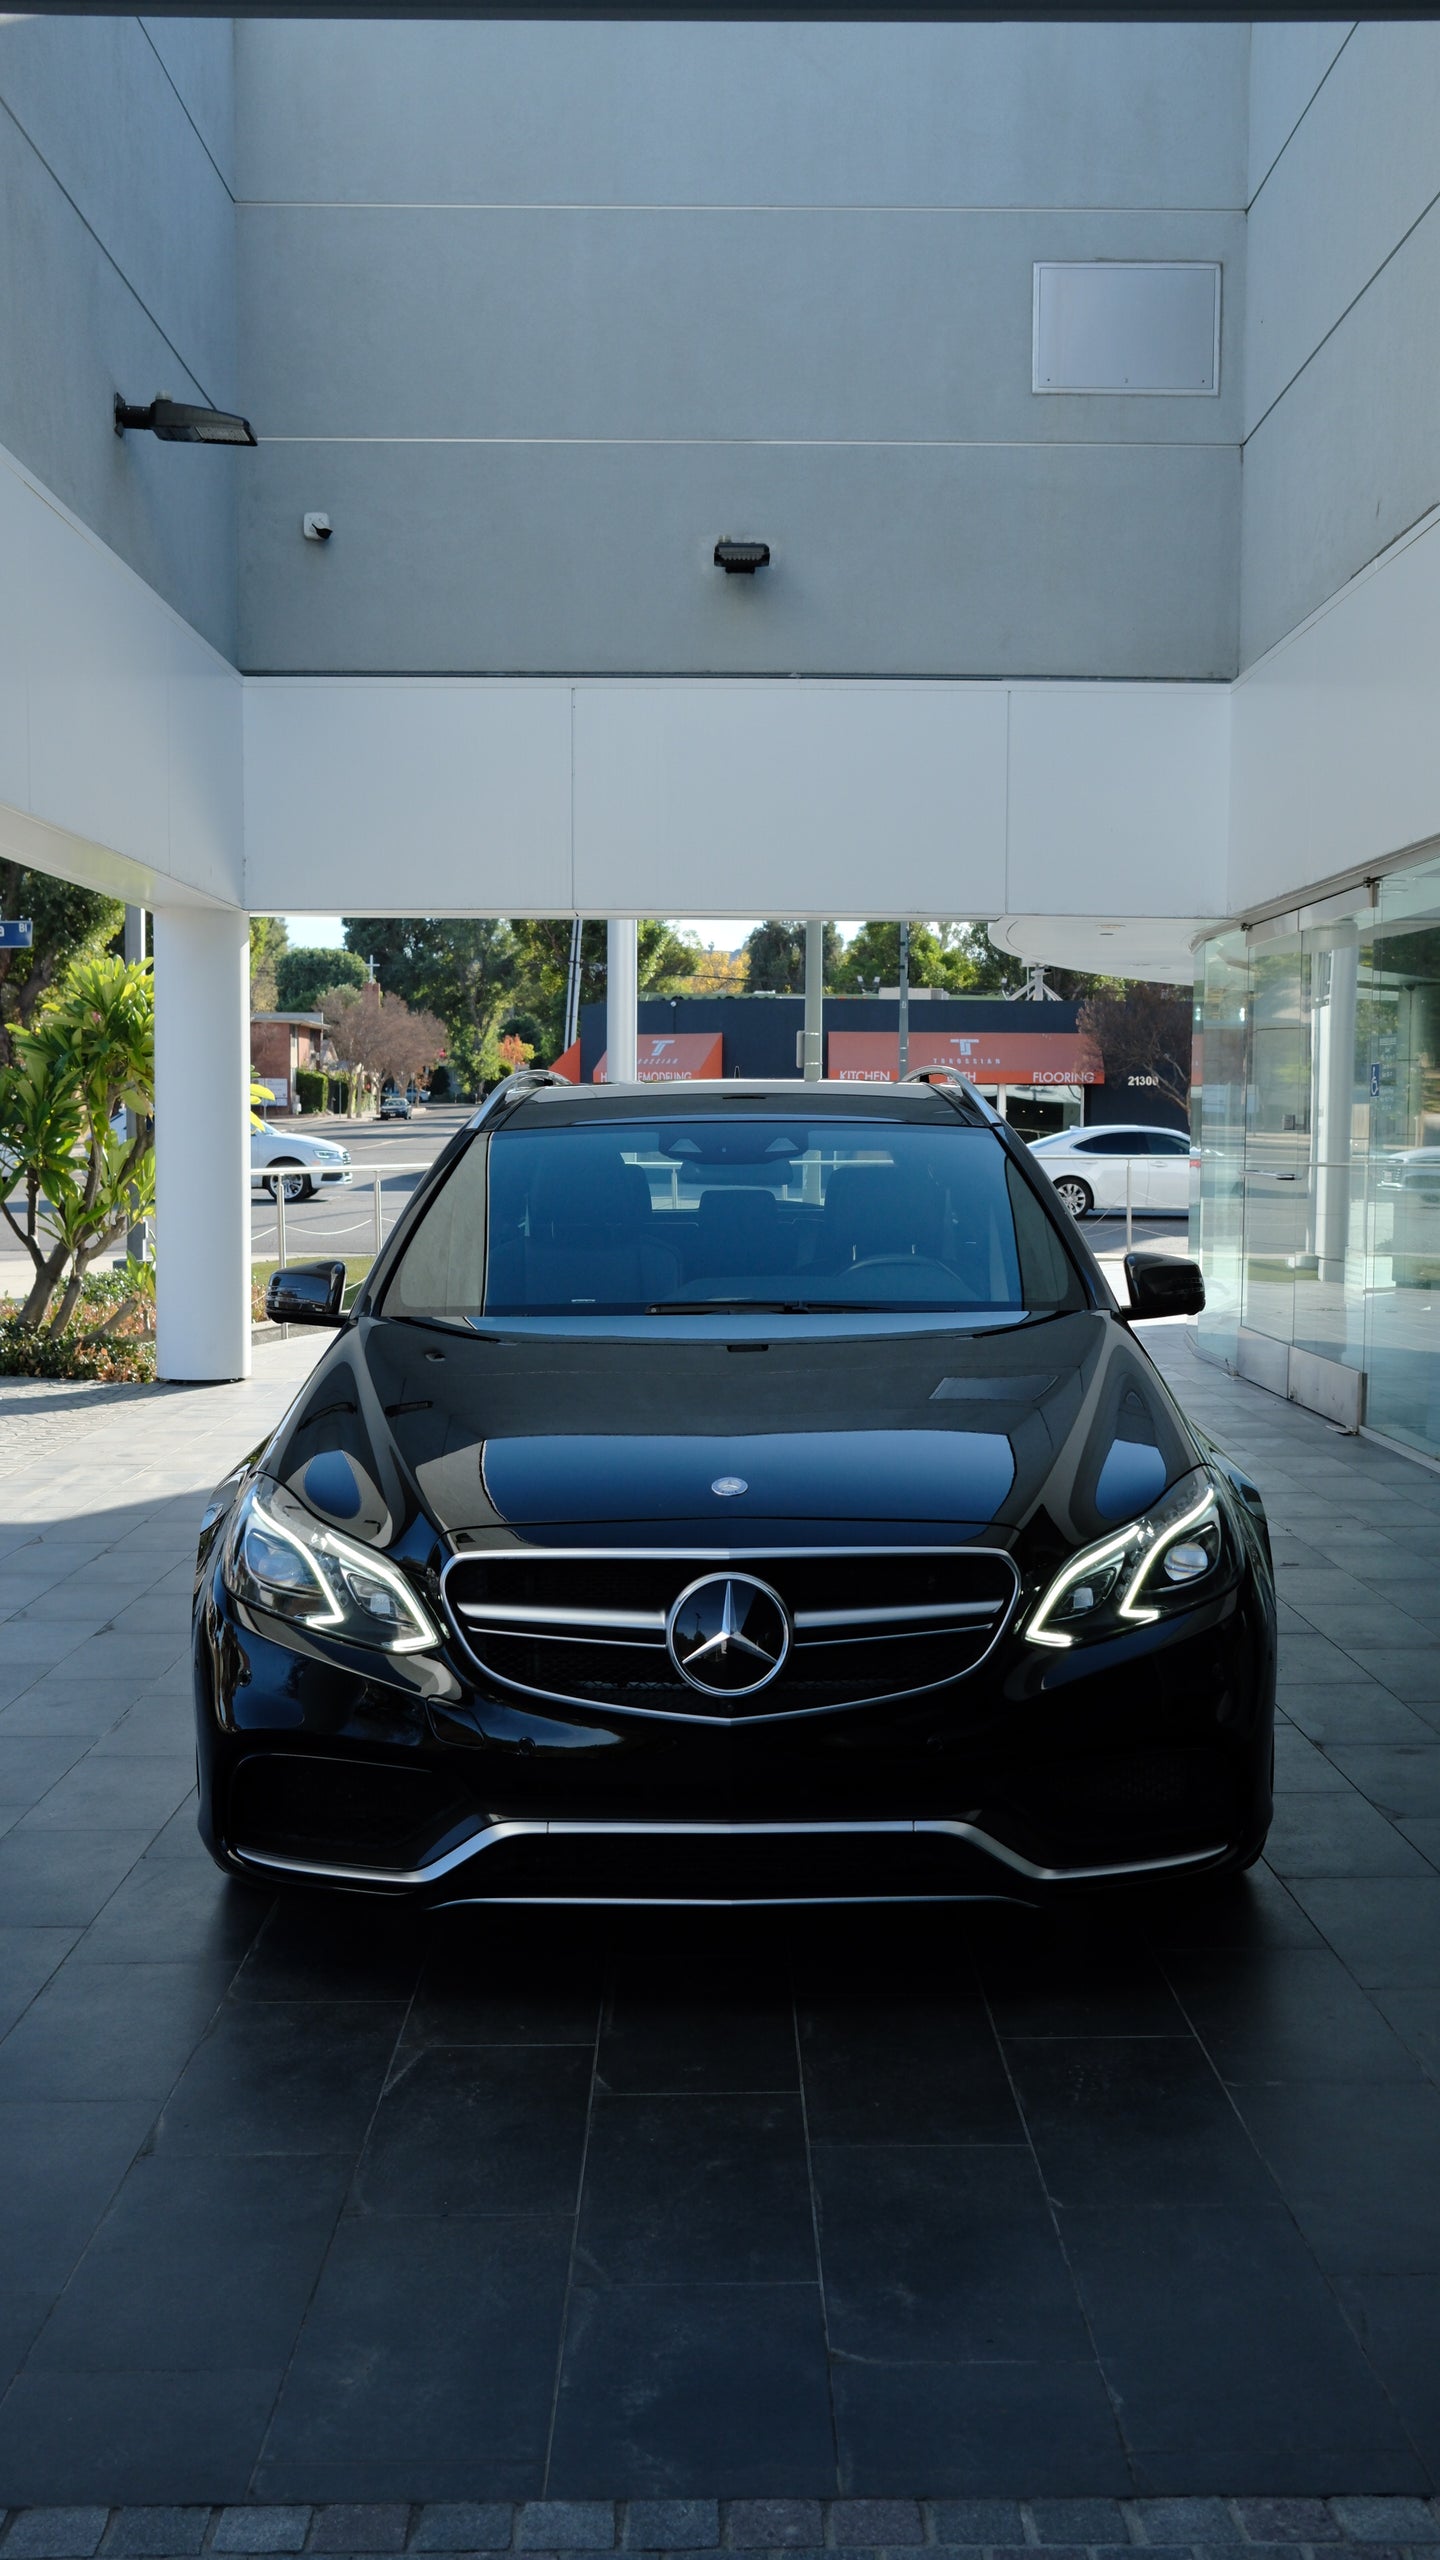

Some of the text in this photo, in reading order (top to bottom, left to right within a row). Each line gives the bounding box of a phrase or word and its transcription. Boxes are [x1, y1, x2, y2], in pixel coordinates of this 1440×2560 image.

[637, 1072, 692, 1080] EMODELING
[839, 1071, 890, 1081] KITCHEN
[1033, 1072, 1095, 1083] FLOORING
[1128, 1076, 1159, 1087] 21300
